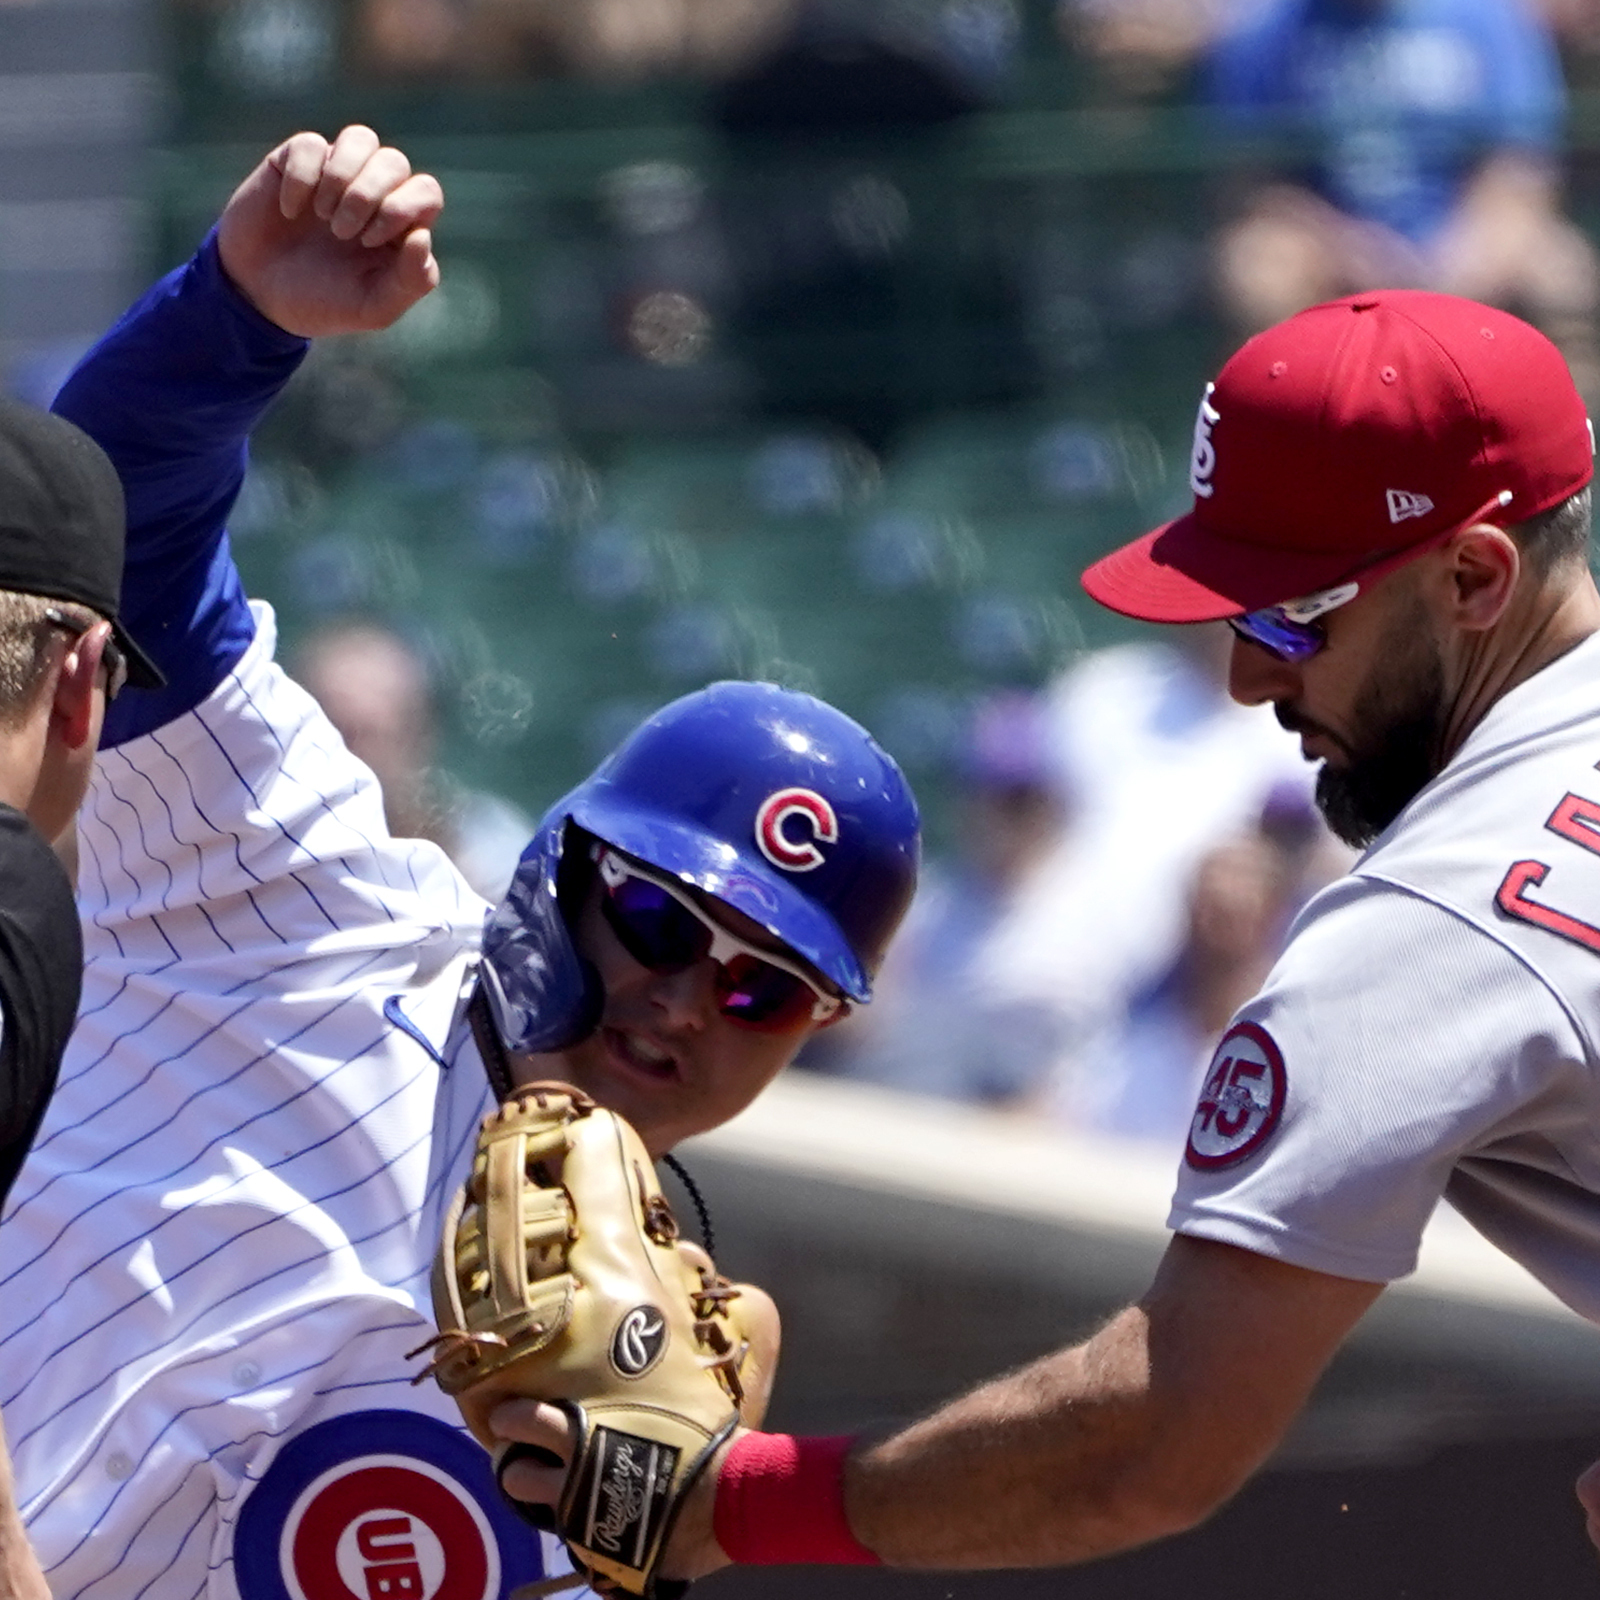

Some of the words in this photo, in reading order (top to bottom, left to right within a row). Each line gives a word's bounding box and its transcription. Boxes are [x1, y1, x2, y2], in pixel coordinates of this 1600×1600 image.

[755, 787, 838, 882] C
[1197, 1056, 1267, 1138] 45
[592, 1442, 643, 1552] Rawlings
